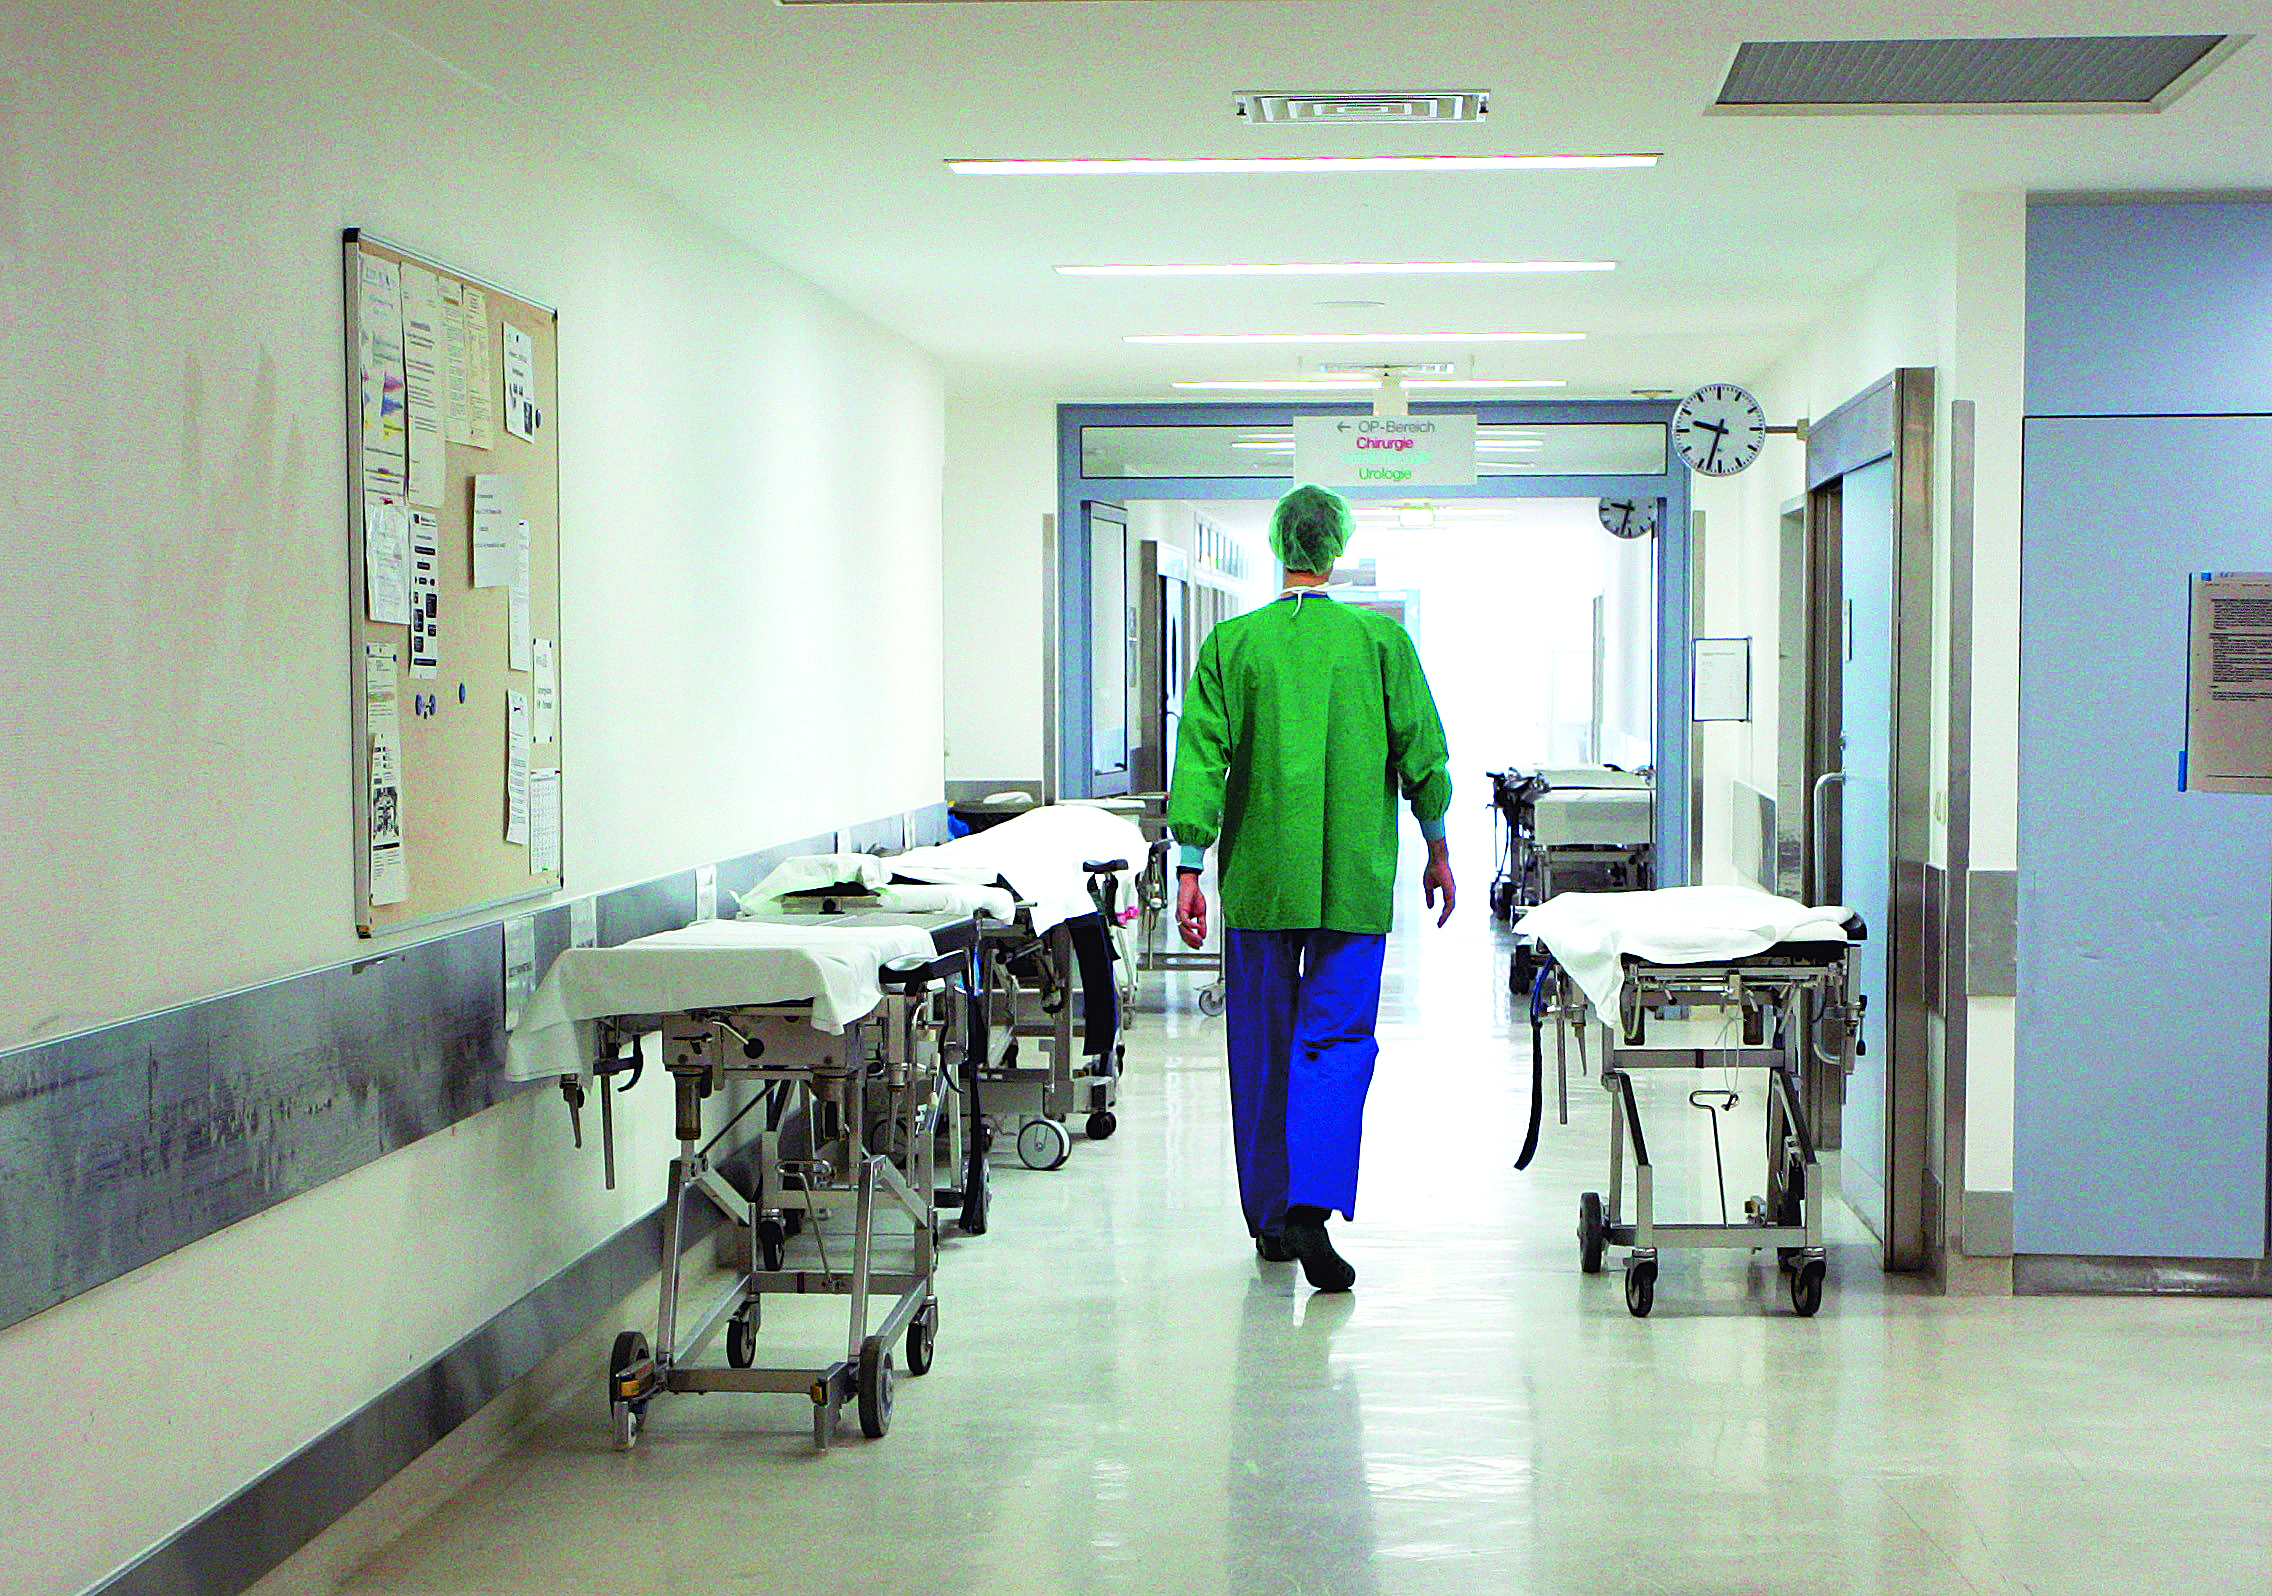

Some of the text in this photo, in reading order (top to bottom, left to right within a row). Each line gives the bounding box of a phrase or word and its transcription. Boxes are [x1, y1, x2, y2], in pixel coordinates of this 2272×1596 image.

[1358, 420, 1435, 433] OP-Bereich
[1356, 436, 1414, 452] Chirurgie
[1359, 467, 1412, 481] Urologie
